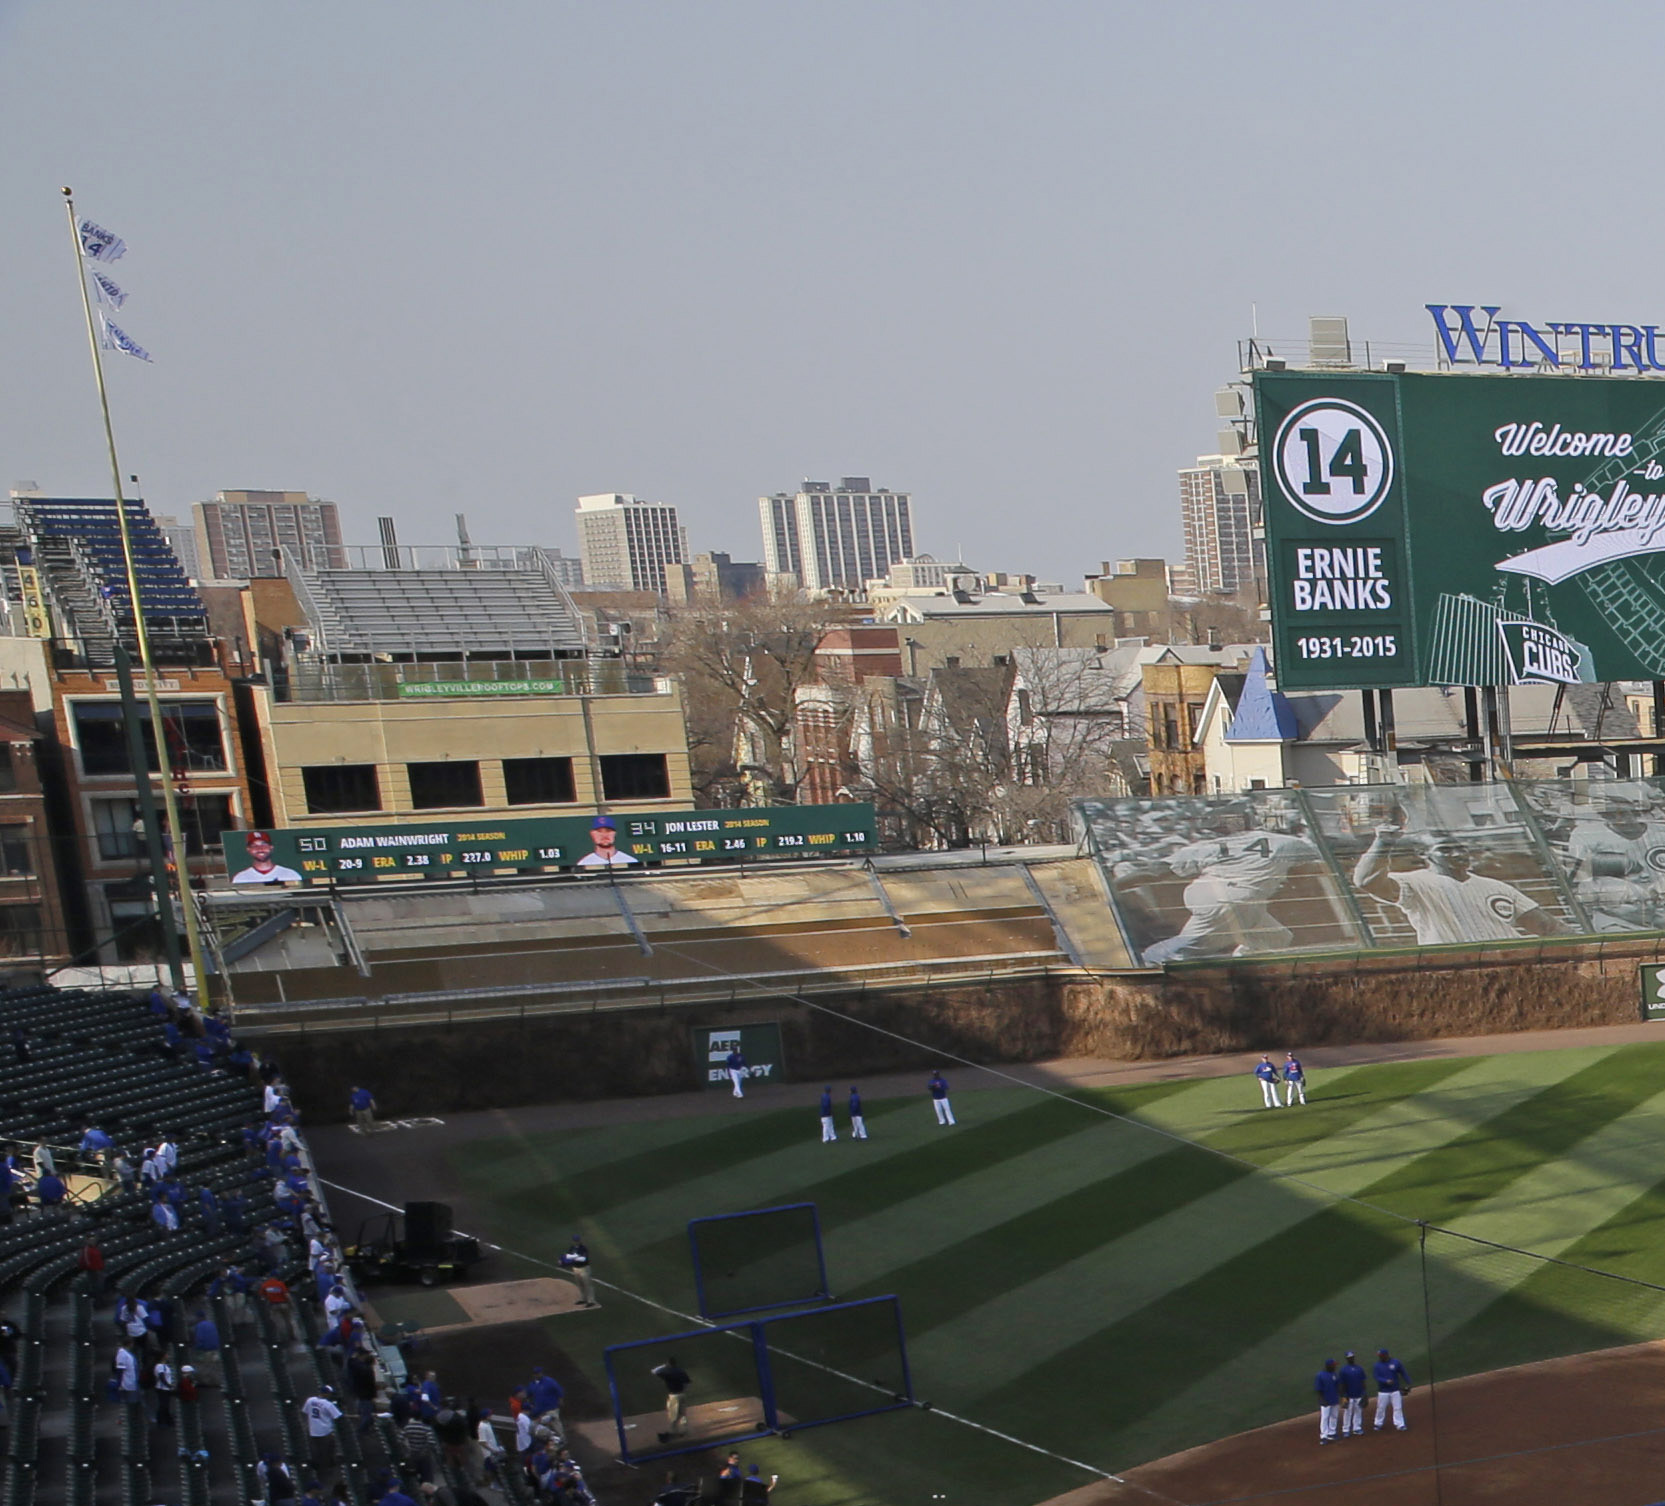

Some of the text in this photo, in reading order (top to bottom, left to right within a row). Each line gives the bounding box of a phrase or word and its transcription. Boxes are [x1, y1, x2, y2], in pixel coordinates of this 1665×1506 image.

[1494, 422, 1632, 457] Welcome
[1299, 428, 1368, 496] 14
[1297, 548, 1383, 578] ERNIE
[1294, 579, 1391, 611] BANKS
[1297, 636, 1396, 659] 1931-2015
[665, 822, 685, 834] JON
[687, 820, 719, 832] LESTER
[340, 837, 374, 849] ADAM
[376, 833, 449, 847] WAINWRIGHT
[632, 843, 653, 854] W-L
[660, 842, 687, 853] 16-11
[694, 840, 715, 852] ERA
[756, 837, 767, 848] IP
[808, 834, 835, 845] WHIP
[303, 860, 328, 871] W-L
[338, 857, 363, 869] 20-9
[374, 856, 396, 868] ERA
[441, 853, 453, 864] IP
[498, 850, 529, 862] WHIP
[539, 848, 561, 859] 1.03
[708, 1063, 773, 1082] ENRGY
